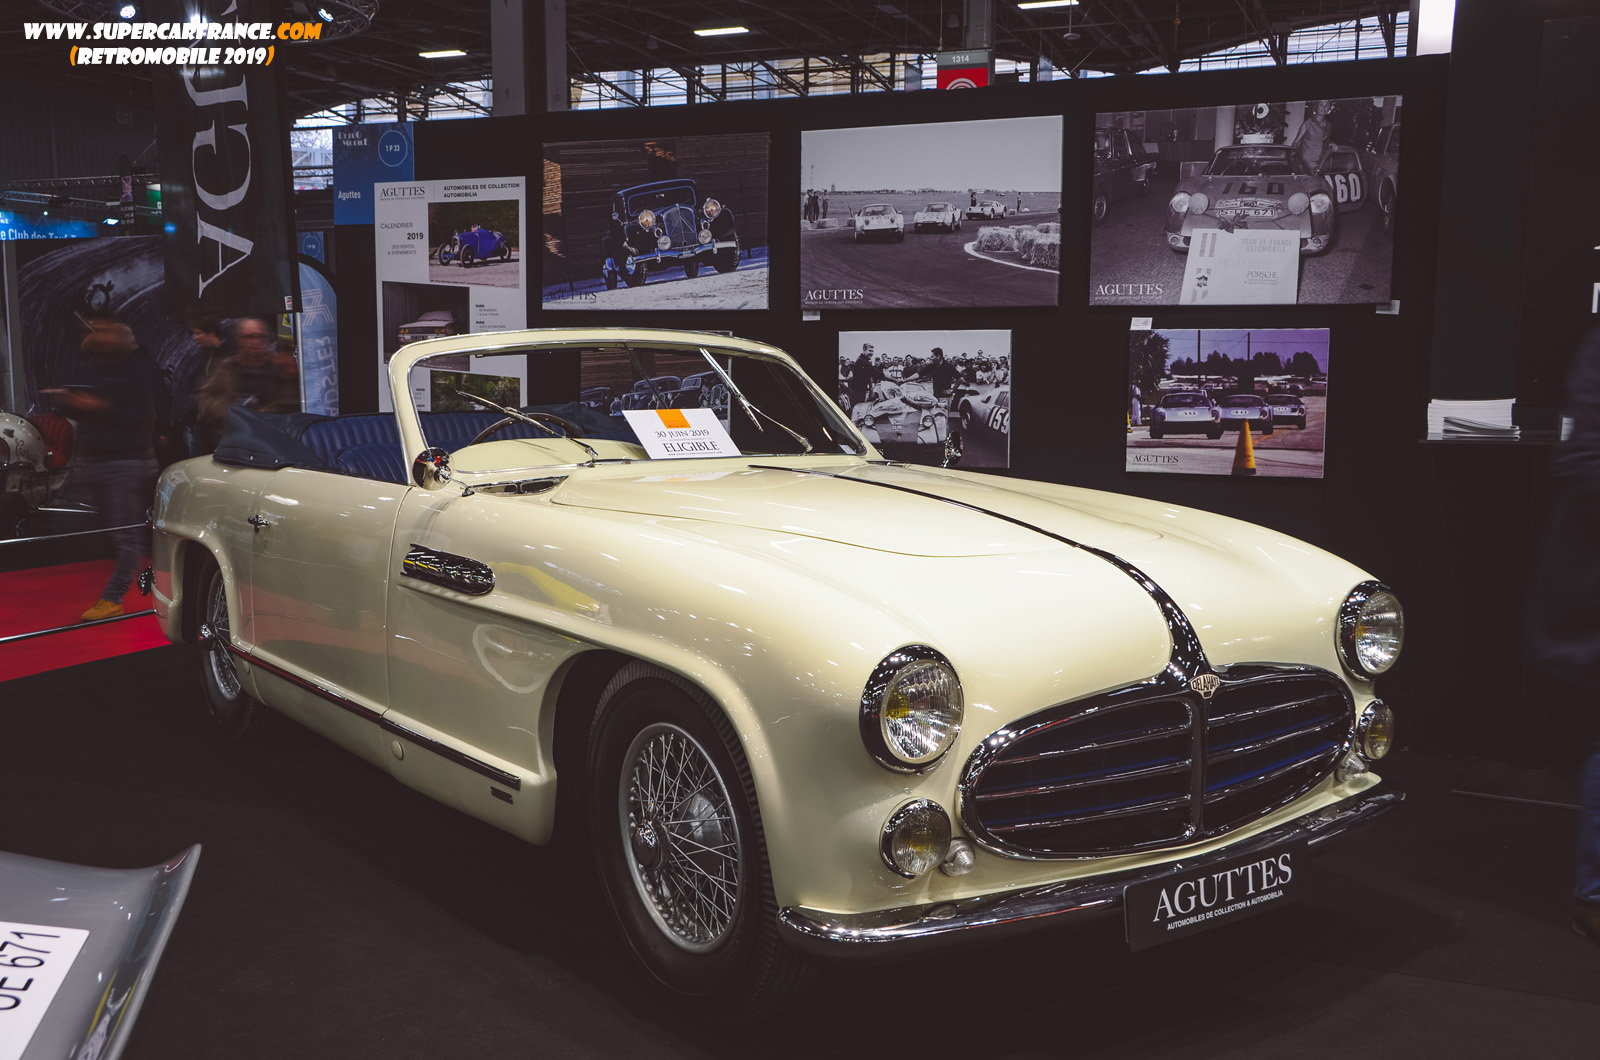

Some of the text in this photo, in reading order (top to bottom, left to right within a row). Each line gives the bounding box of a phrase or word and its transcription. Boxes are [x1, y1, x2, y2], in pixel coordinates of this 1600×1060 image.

[951, 55, 970, 63] 1314
[338, 190, 361, 201] Aguttes
[380, 186, 425, 197] AGUTTES
[407, 232, 424, 240] 2019
[1241, 238, 1257, 246] TOUR
[1269, 239, 1292, 247] FRANCE
[1246, 245, 1287, 253] AUTOMOBILE
[1246, 270, 1279, 278] PORSCHE
[805, 288, 864, 300] AGUTTES
[1095, 283, 1163, 295] AGUTTES
[654, 429, 710, 438] 30 JUIN 2019
[662, 440, 720, 452] ELIGIBLE
[1132, 454, 1179, 464] AGUTTES
[1152, 853, 1293, 923] AGUTTES
[1167, 913, 1206, 931] AUTOMOBILES
[1205, 911, 1214, 919] DE
[1213, 901, 1247, 917] COLLECTION
[1250, 889, 1284, 905] AUTOMOBILIA
